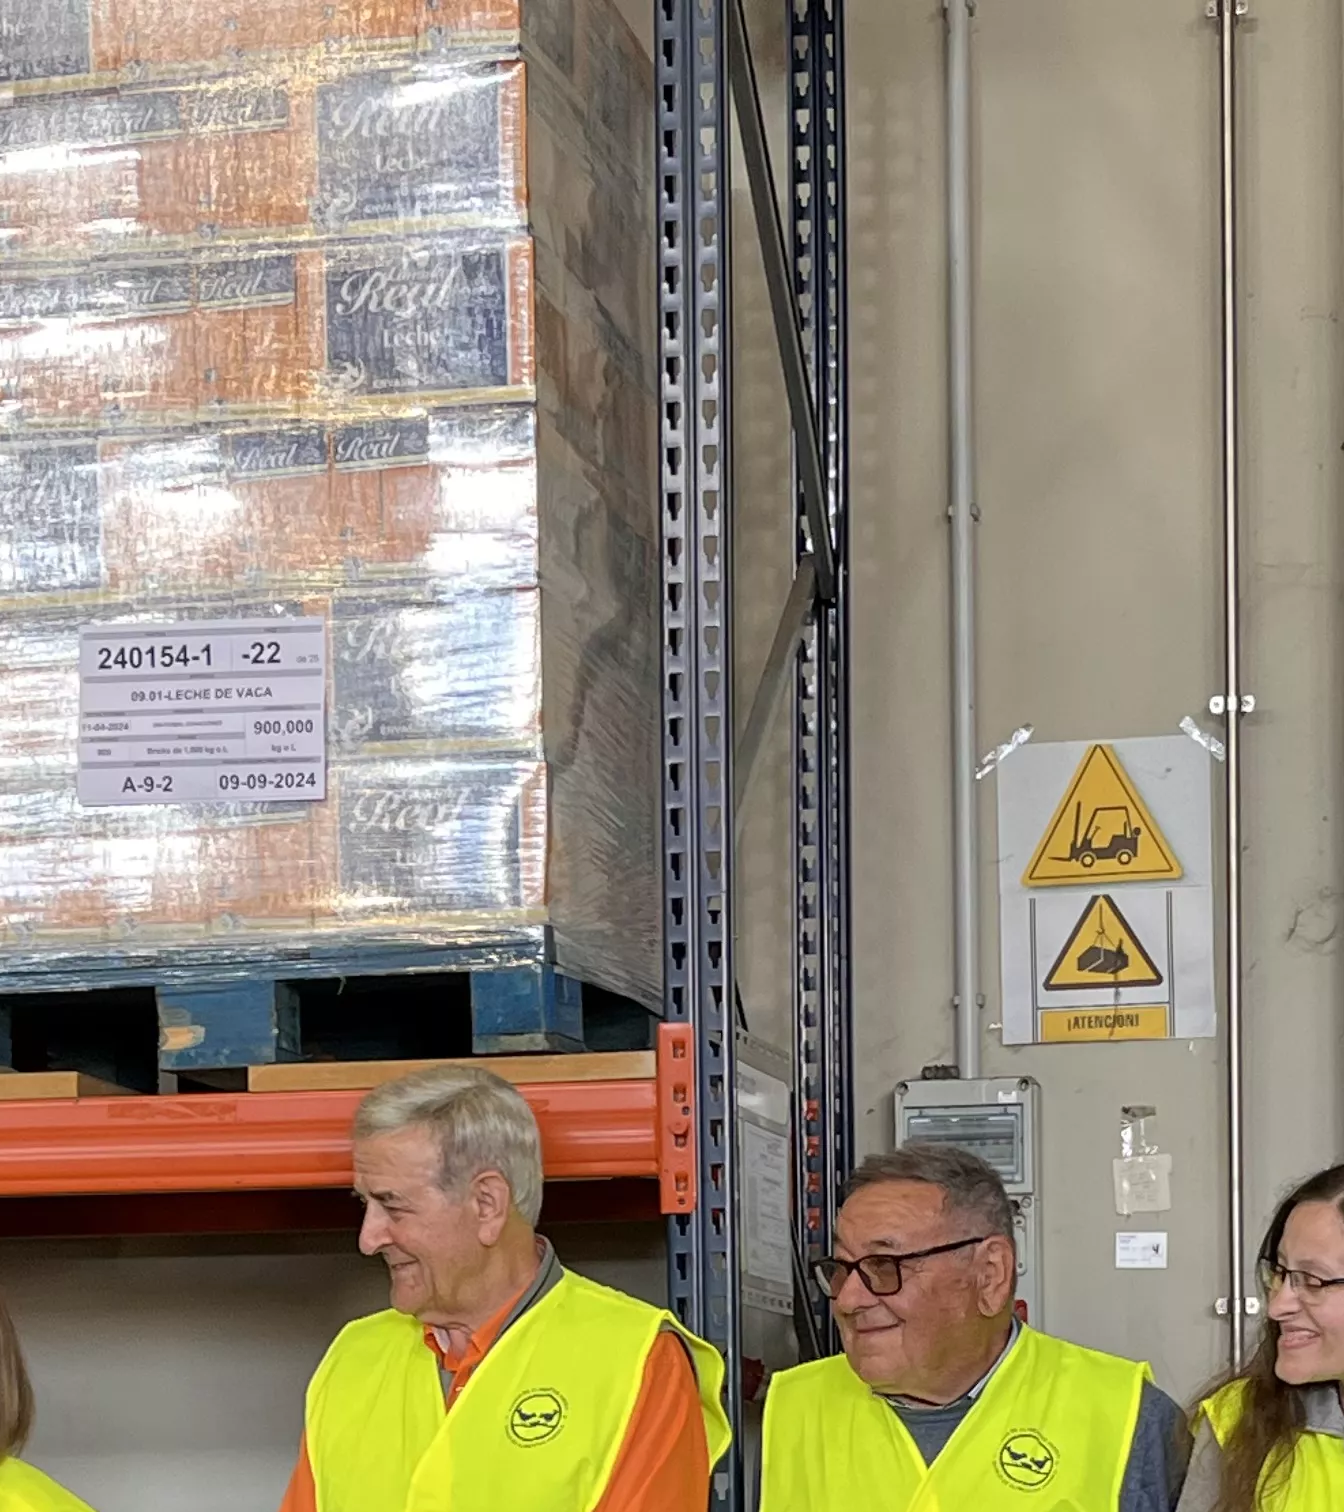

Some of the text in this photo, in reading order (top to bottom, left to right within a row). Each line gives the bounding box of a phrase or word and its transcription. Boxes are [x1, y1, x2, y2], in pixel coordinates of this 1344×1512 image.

[97, 643, 213, 670] 240154-1
[241, 641, 282, 665] -22
[130, 686, 273, 702] 09.01-LECHE DE VACA
[253, 719, 314, 736] 900,000
[121, 772, 317, 793] A-9-2 09-09-2024
